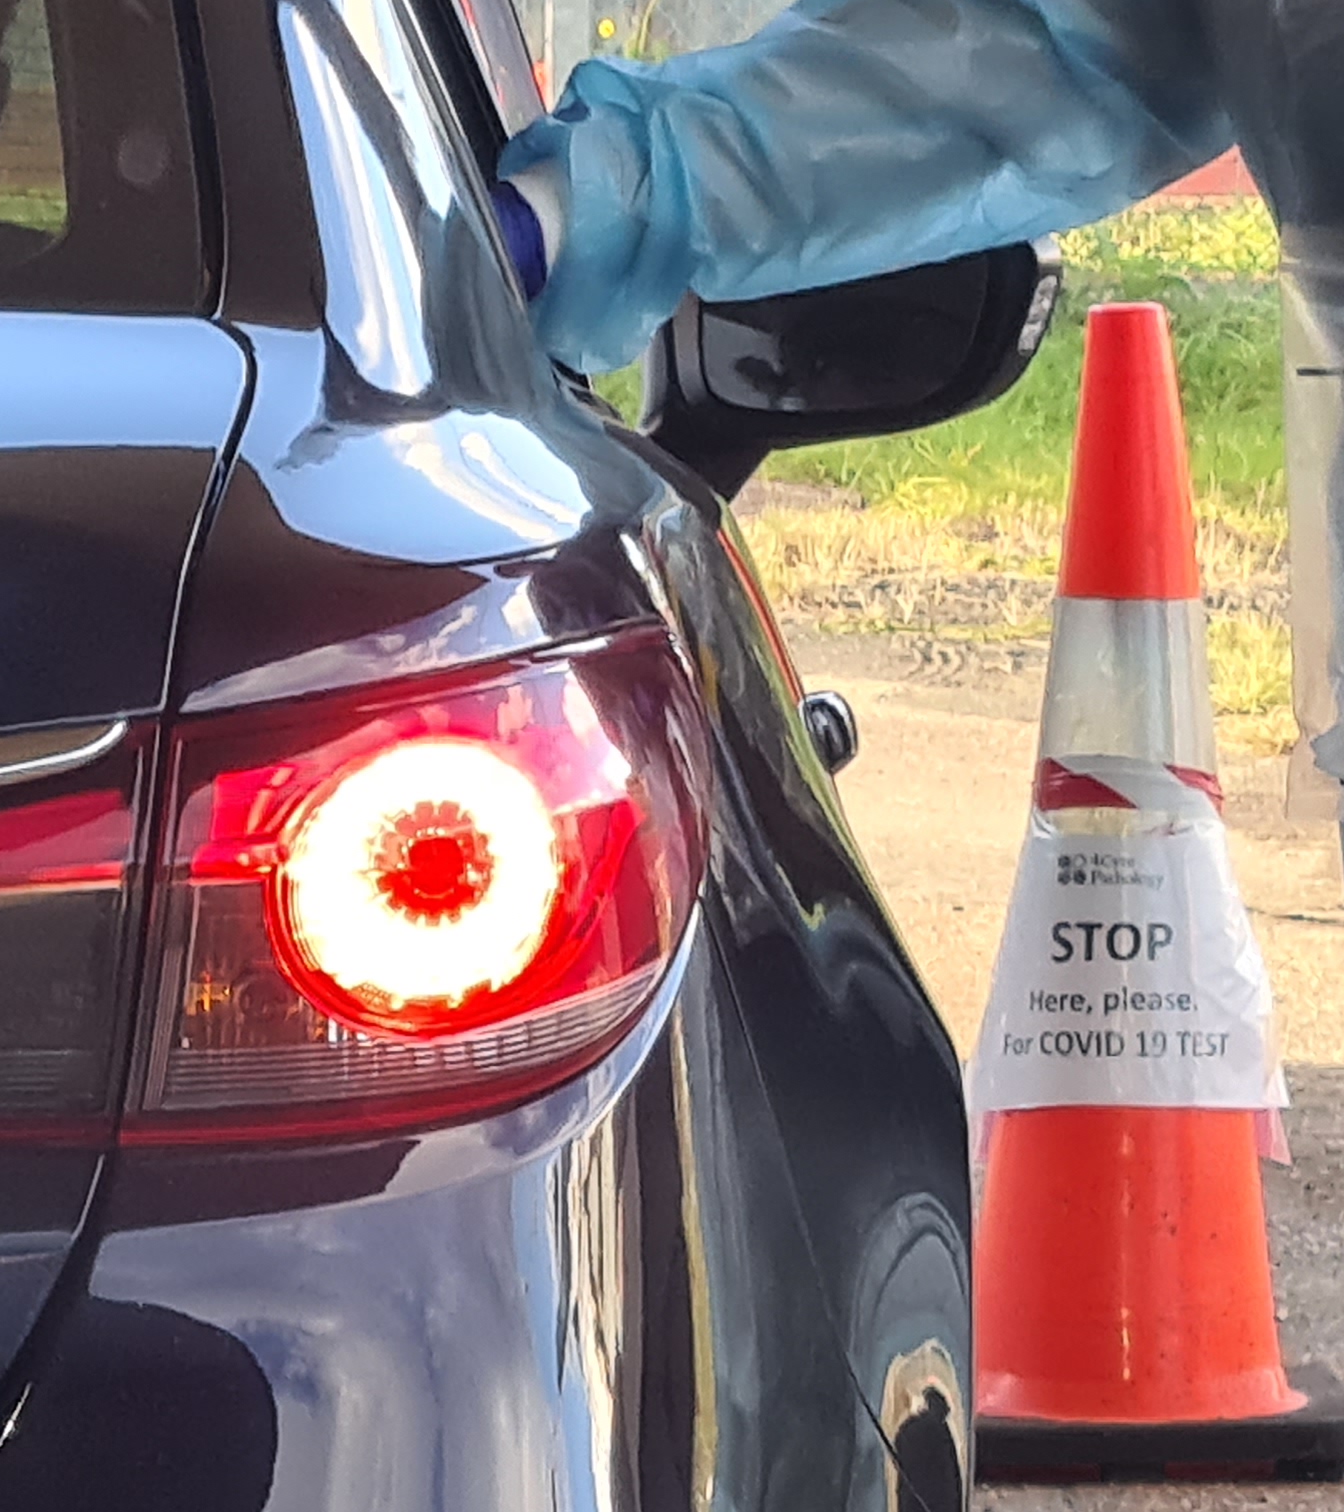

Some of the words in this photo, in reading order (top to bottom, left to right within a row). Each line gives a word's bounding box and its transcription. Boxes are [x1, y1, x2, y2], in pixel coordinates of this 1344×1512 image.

[1051, 921, 1174, 964] STOP
[1029, 990, 1093, 1015] Here,
[1002, 1033, 1034, 1055] For
[1039, 1030, 1125, 1057] COVID
[1136, 1030, 1167, 1057] 19
[1176, 1031, 1230, 1057] TEST
